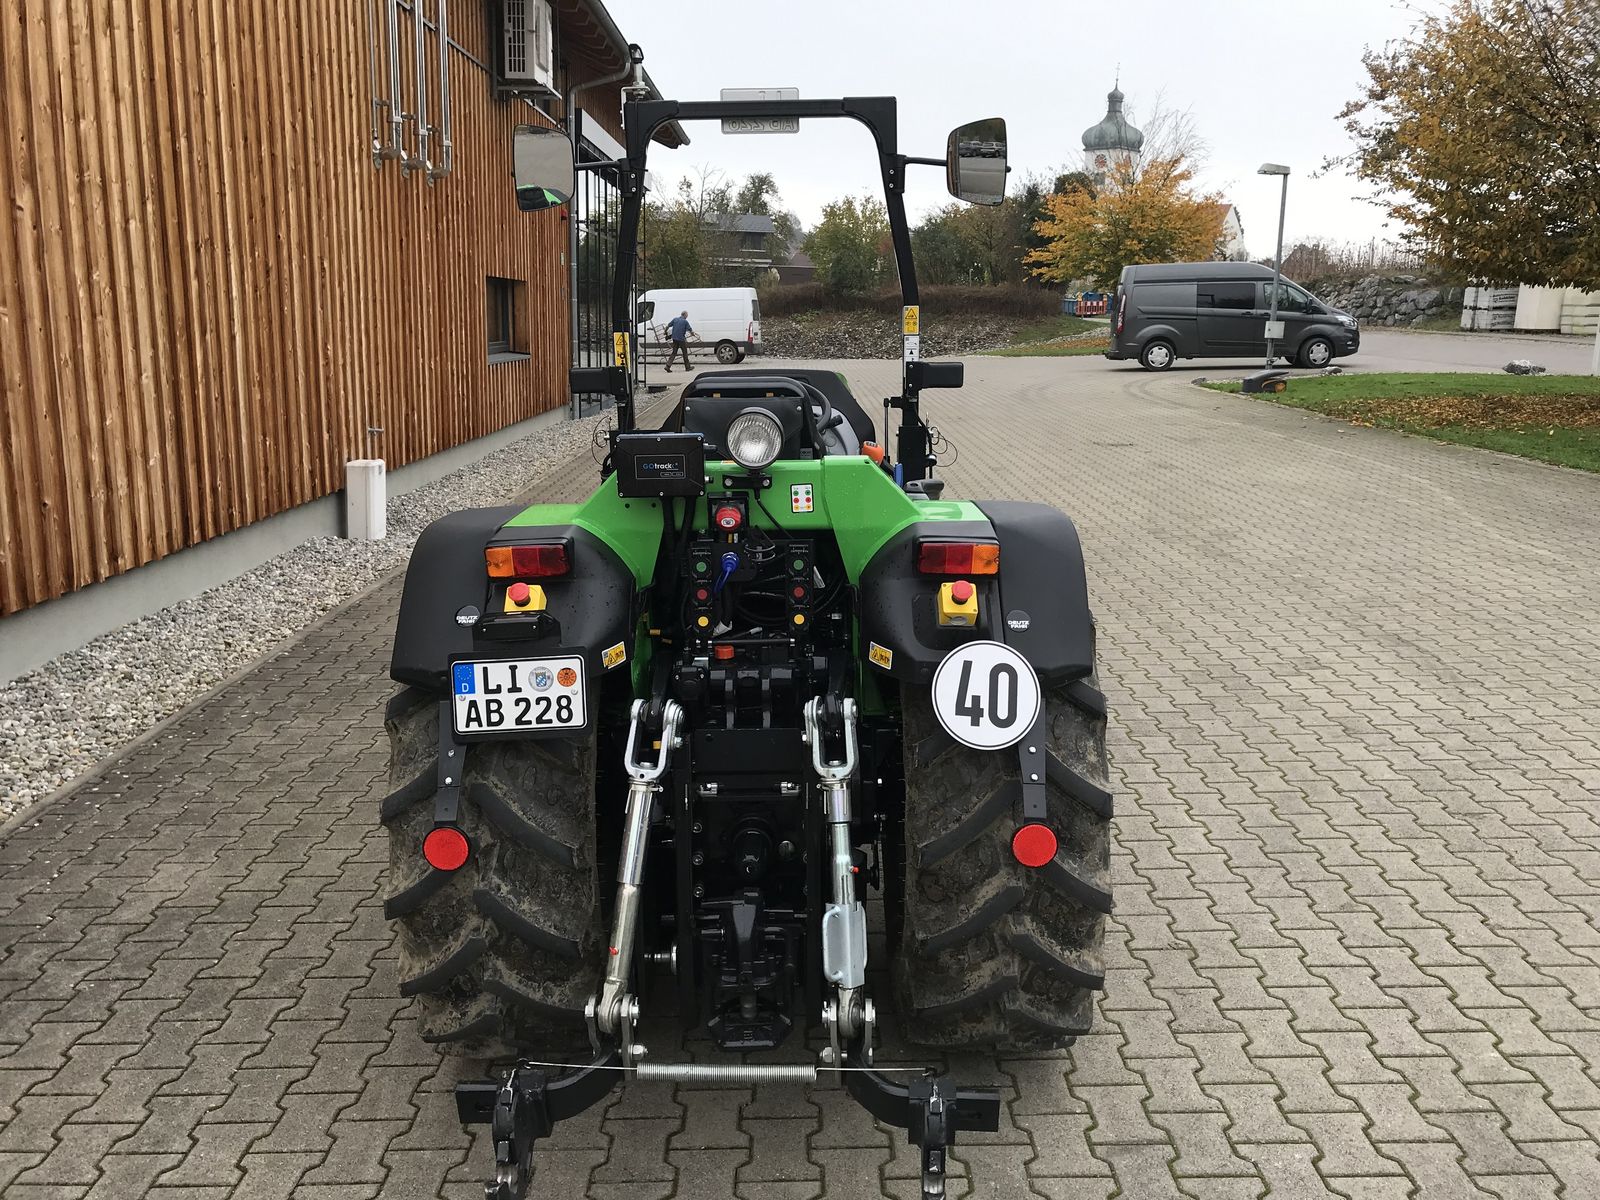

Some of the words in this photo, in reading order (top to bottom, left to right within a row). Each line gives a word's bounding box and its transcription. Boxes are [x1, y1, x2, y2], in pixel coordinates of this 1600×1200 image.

[461, 682, 470, 693] D
[482, 665, 522, 695] LI
[955, 660, 1018, 729] 40
[465, 698, 505, 728] AB
[514, 695, 573, 726] 228
